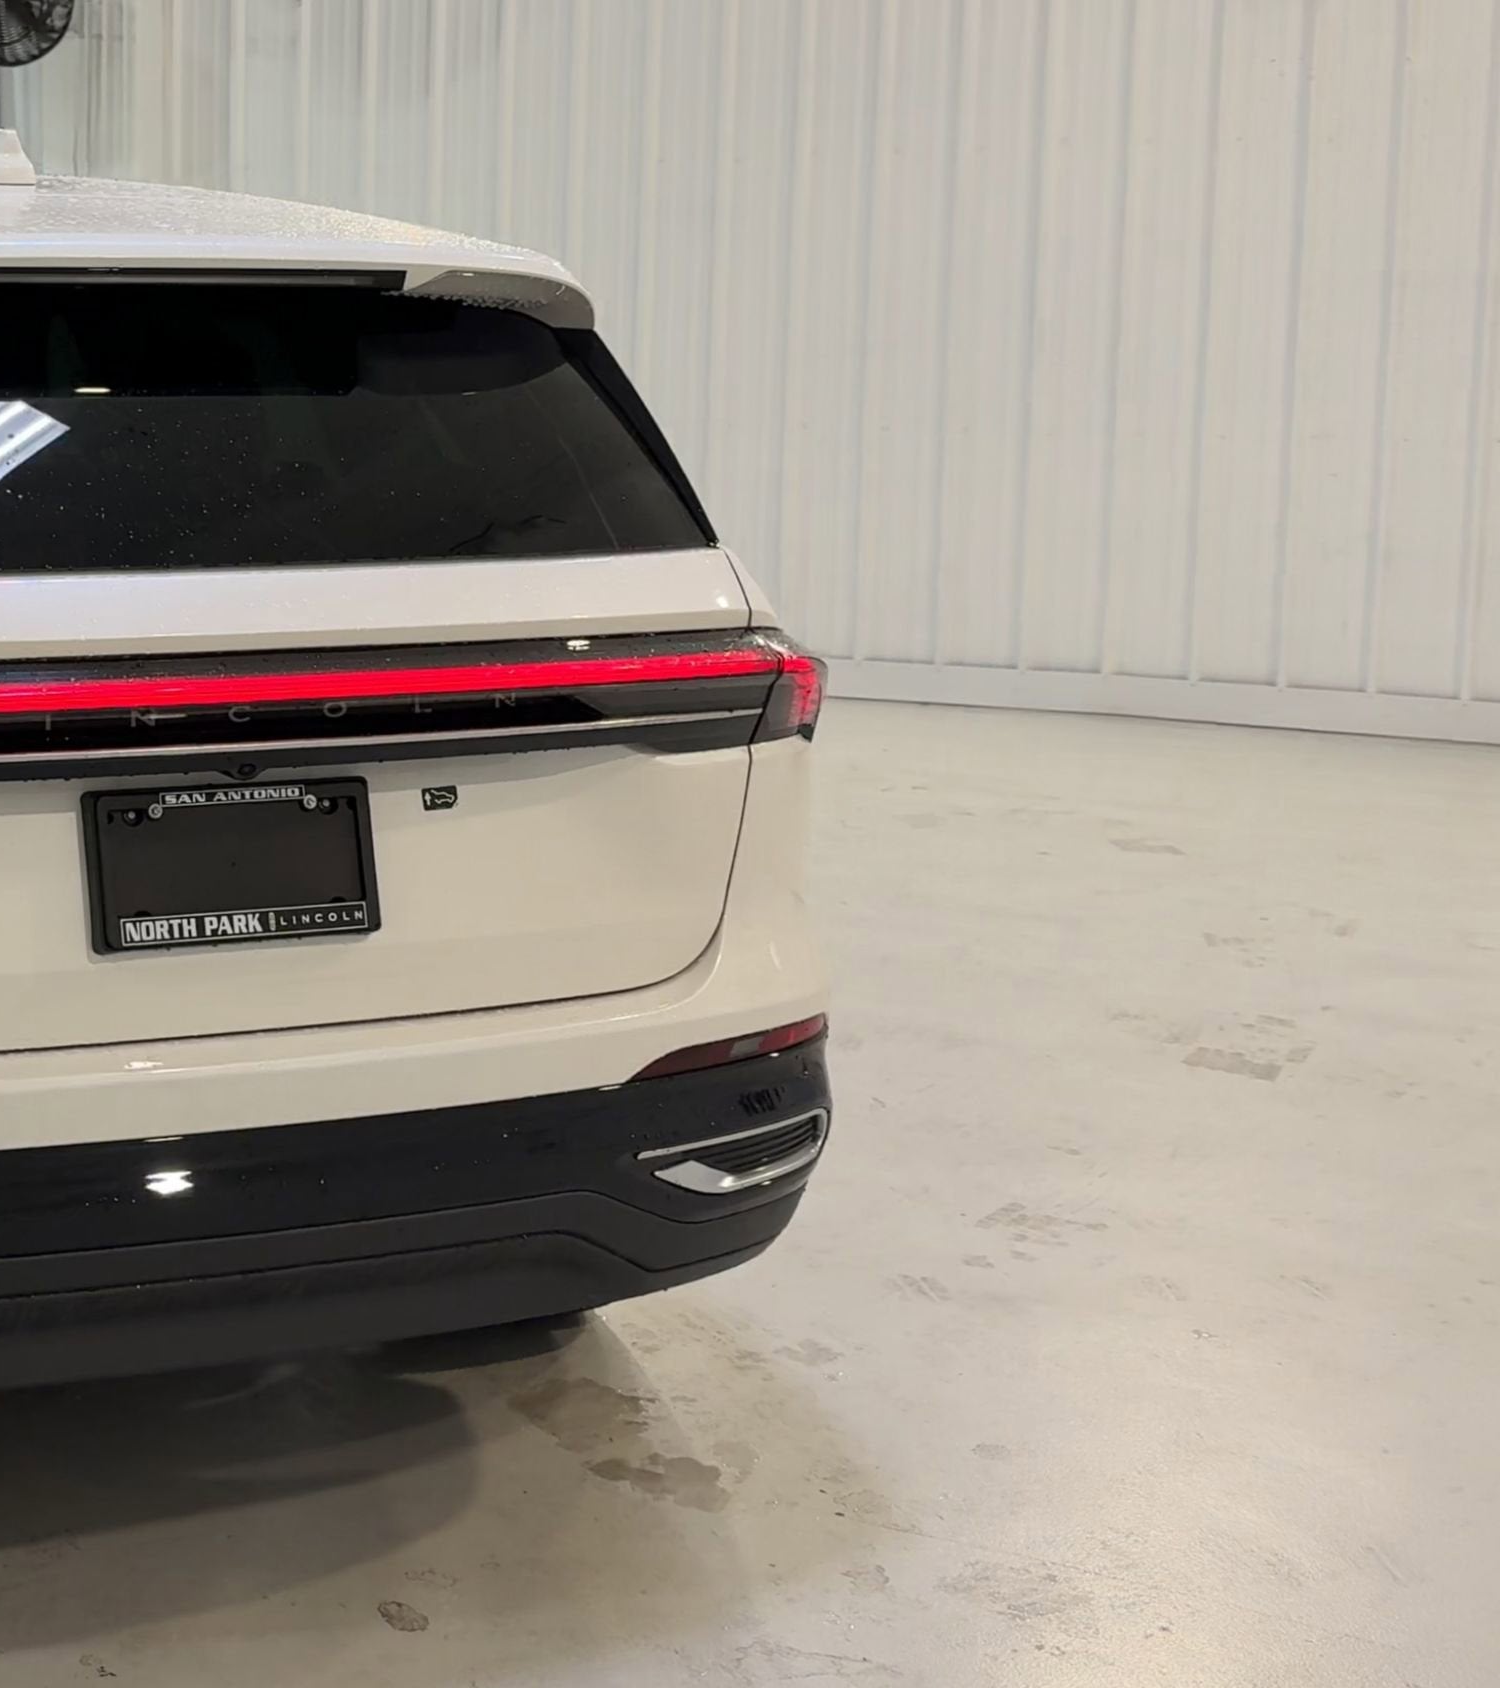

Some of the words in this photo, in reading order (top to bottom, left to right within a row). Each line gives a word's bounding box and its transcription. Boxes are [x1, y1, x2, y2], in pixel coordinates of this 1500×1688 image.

[165, 792, 206, 804] SAN
[212, 787, 301, 802] ANTONIO
[124, 918, 197, 943] NORTH
[205, 913, 263, 936] PARK
[281, 910, 364, 927] LINCOLN
